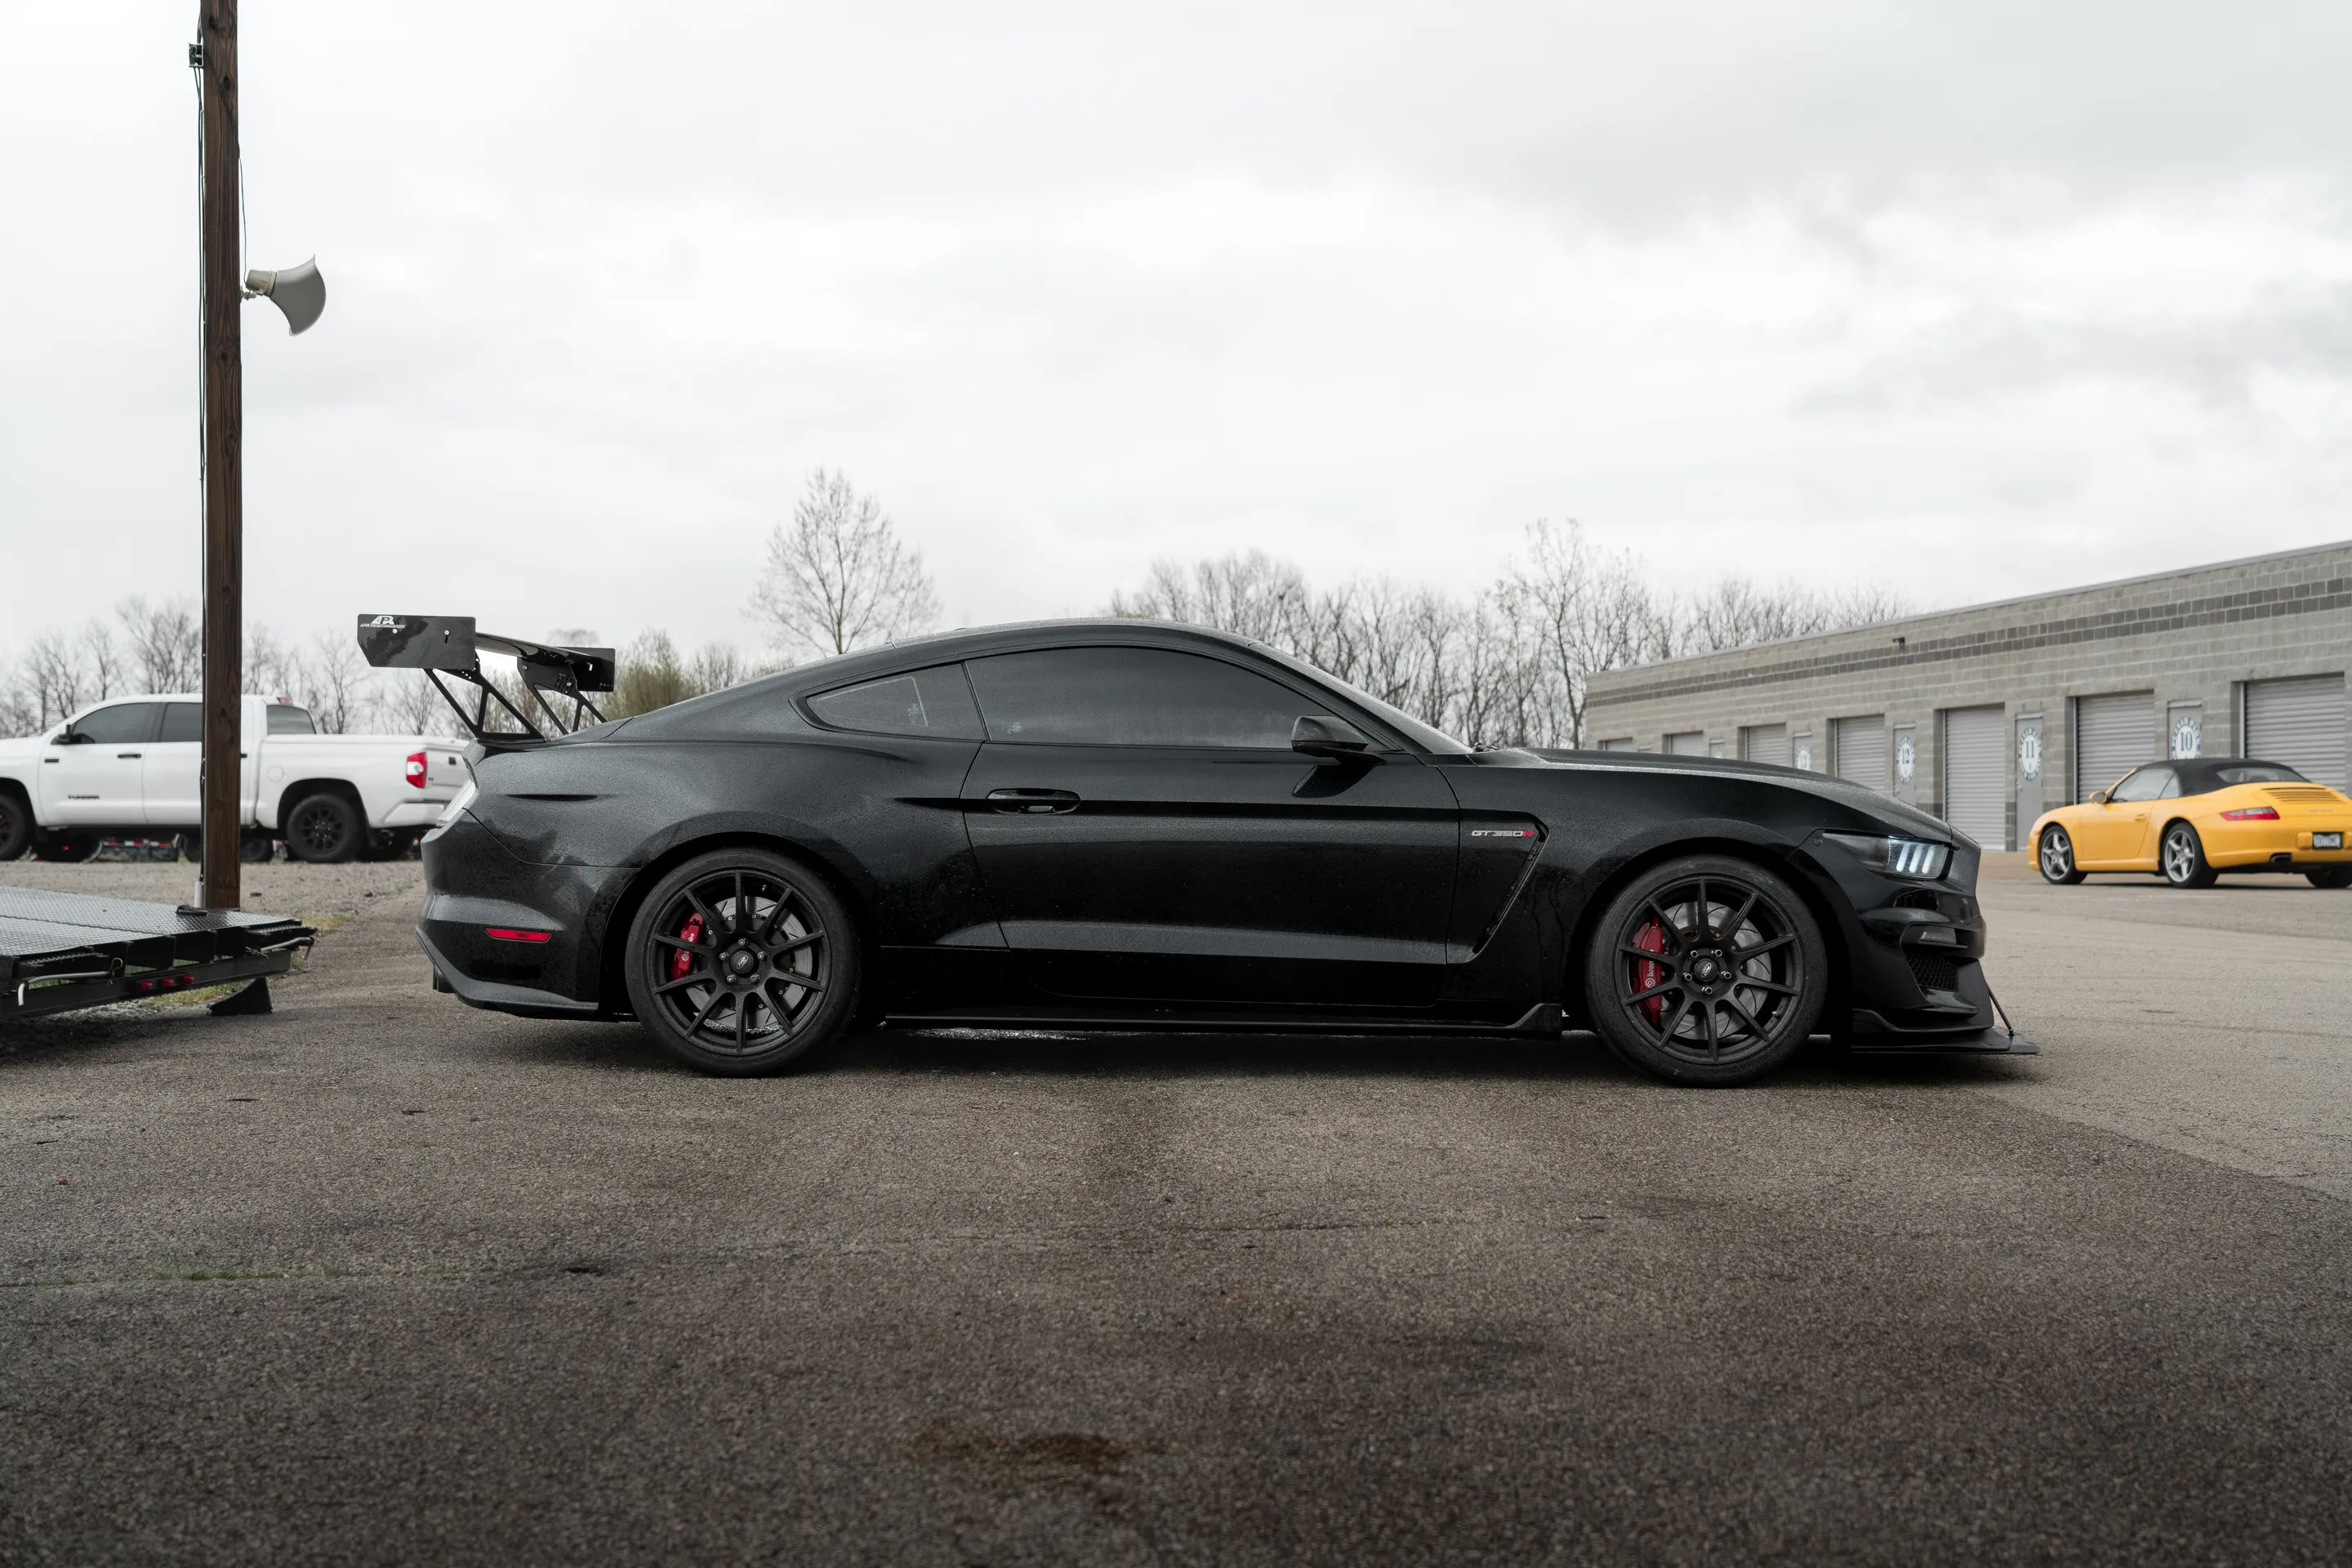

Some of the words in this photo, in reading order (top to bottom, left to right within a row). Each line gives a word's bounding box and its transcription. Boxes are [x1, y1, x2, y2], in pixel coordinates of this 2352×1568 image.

[2025, 741, 2034, 758] 11
[2180, 731, 2193, 751] 10
[1901, 748, 1909, 764] 12
